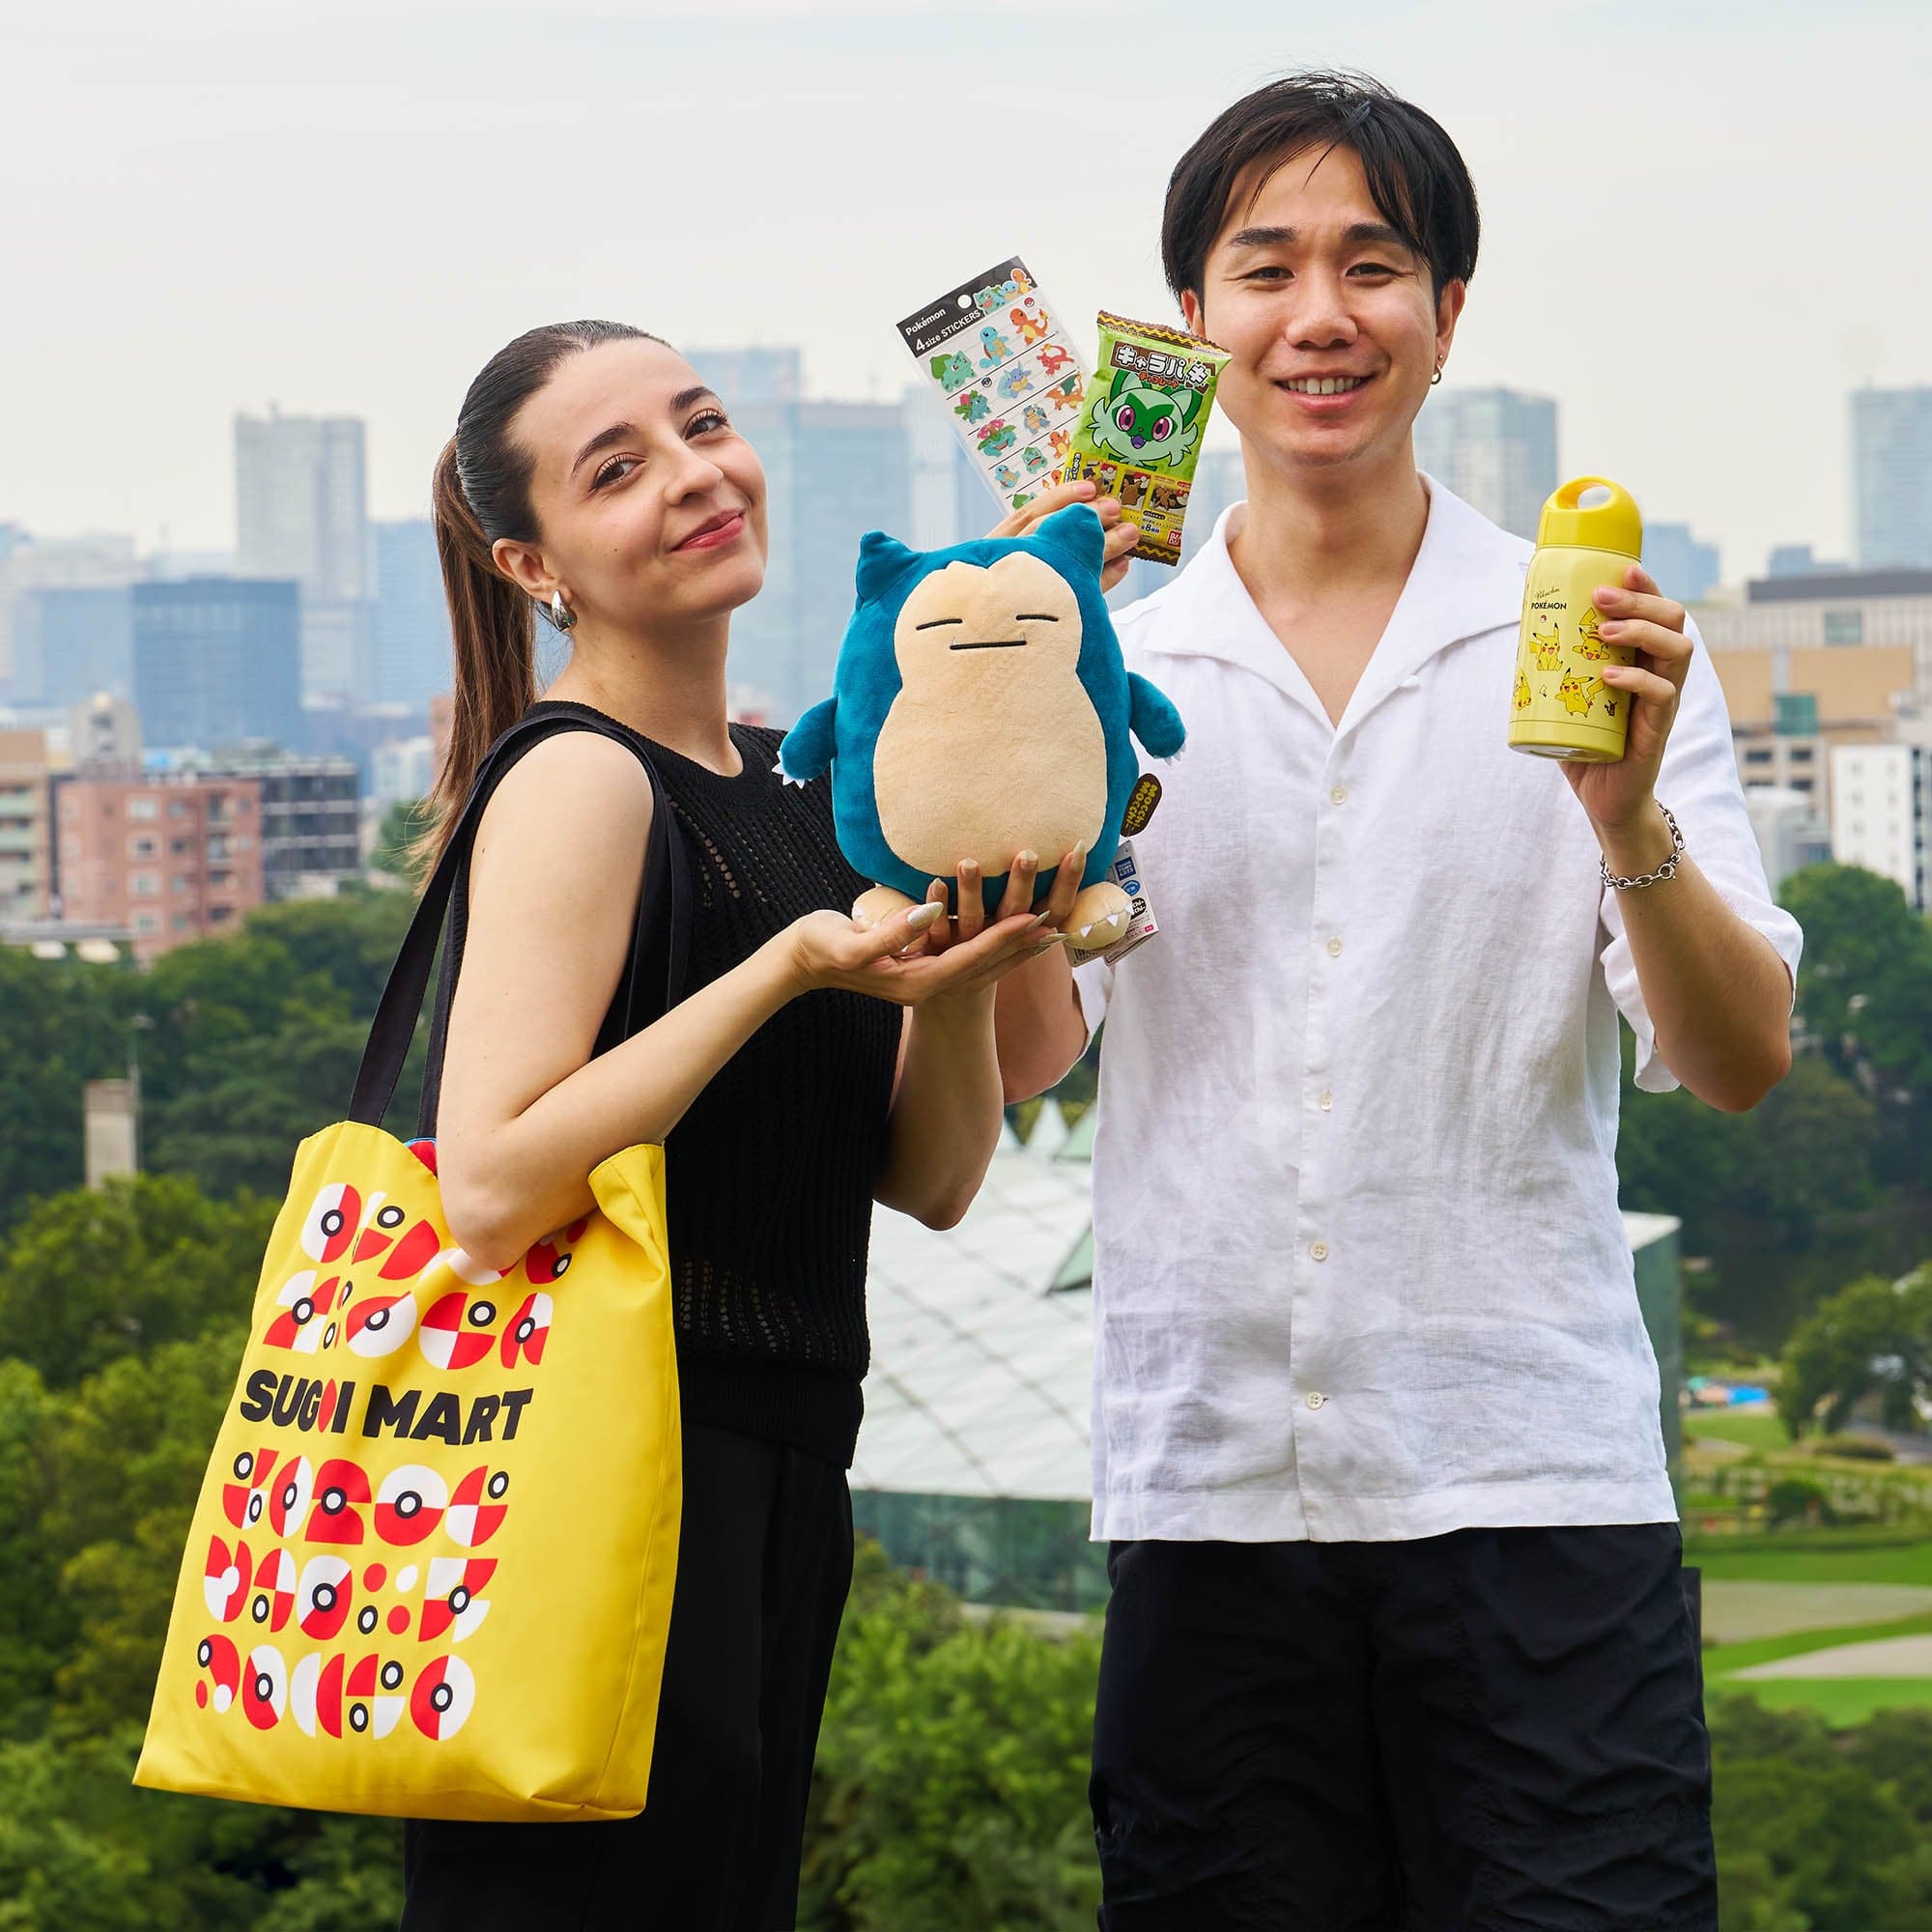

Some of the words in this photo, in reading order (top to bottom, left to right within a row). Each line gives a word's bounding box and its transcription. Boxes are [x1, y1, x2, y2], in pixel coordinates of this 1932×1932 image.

[905, 309, 946, 335] Pokémon
[941, 309, 981, 337] STICKERS
[1139, 371, 1179, 388] チョコレート
[1531, 600, 1567, 610] POKÉMON
[241, 1369, 355, 1434] SUGOI
[362, 1384, 533, 1445] MART
